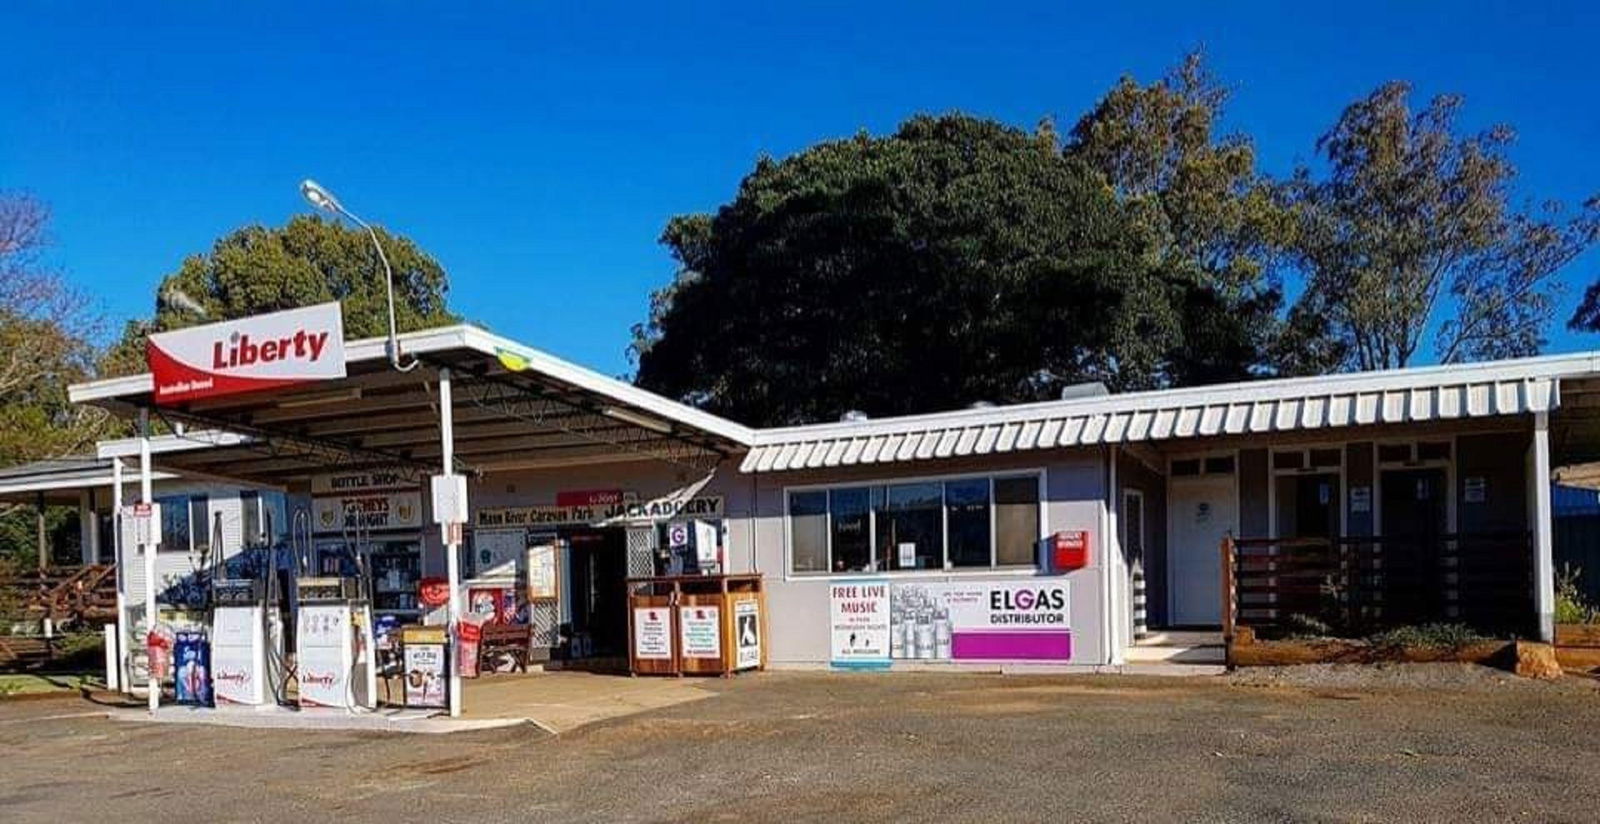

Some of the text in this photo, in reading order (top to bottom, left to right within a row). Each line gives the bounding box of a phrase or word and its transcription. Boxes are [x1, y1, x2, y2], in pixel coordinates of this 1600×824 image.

[213, 330, 328, 370] Liberty
[833, 585, 885, 598] FREE LIVE
[990, 589, 1064, 610] ELGAS
[841, 601, 878, 613] MUSIC
[990, 613, 1064, 624] DISTRIBUTOR
